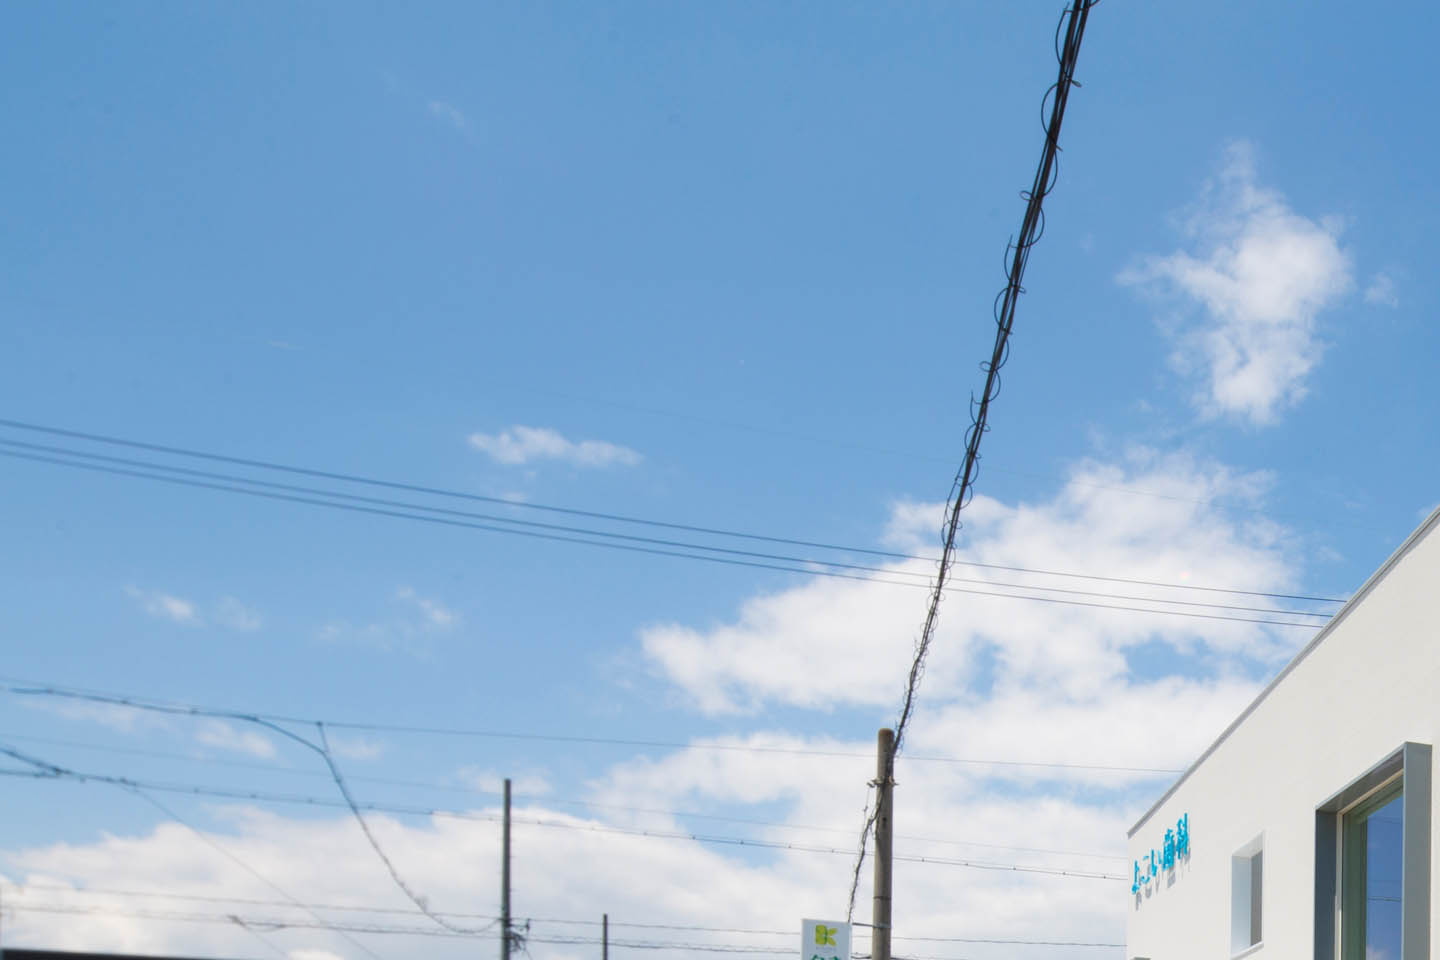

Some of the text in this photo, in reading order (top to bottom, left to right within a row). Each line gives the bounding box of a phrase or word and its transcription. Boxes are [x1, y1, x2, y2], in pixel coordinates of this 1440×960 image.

[1131, 812, 1190, 895] よこい歯科
